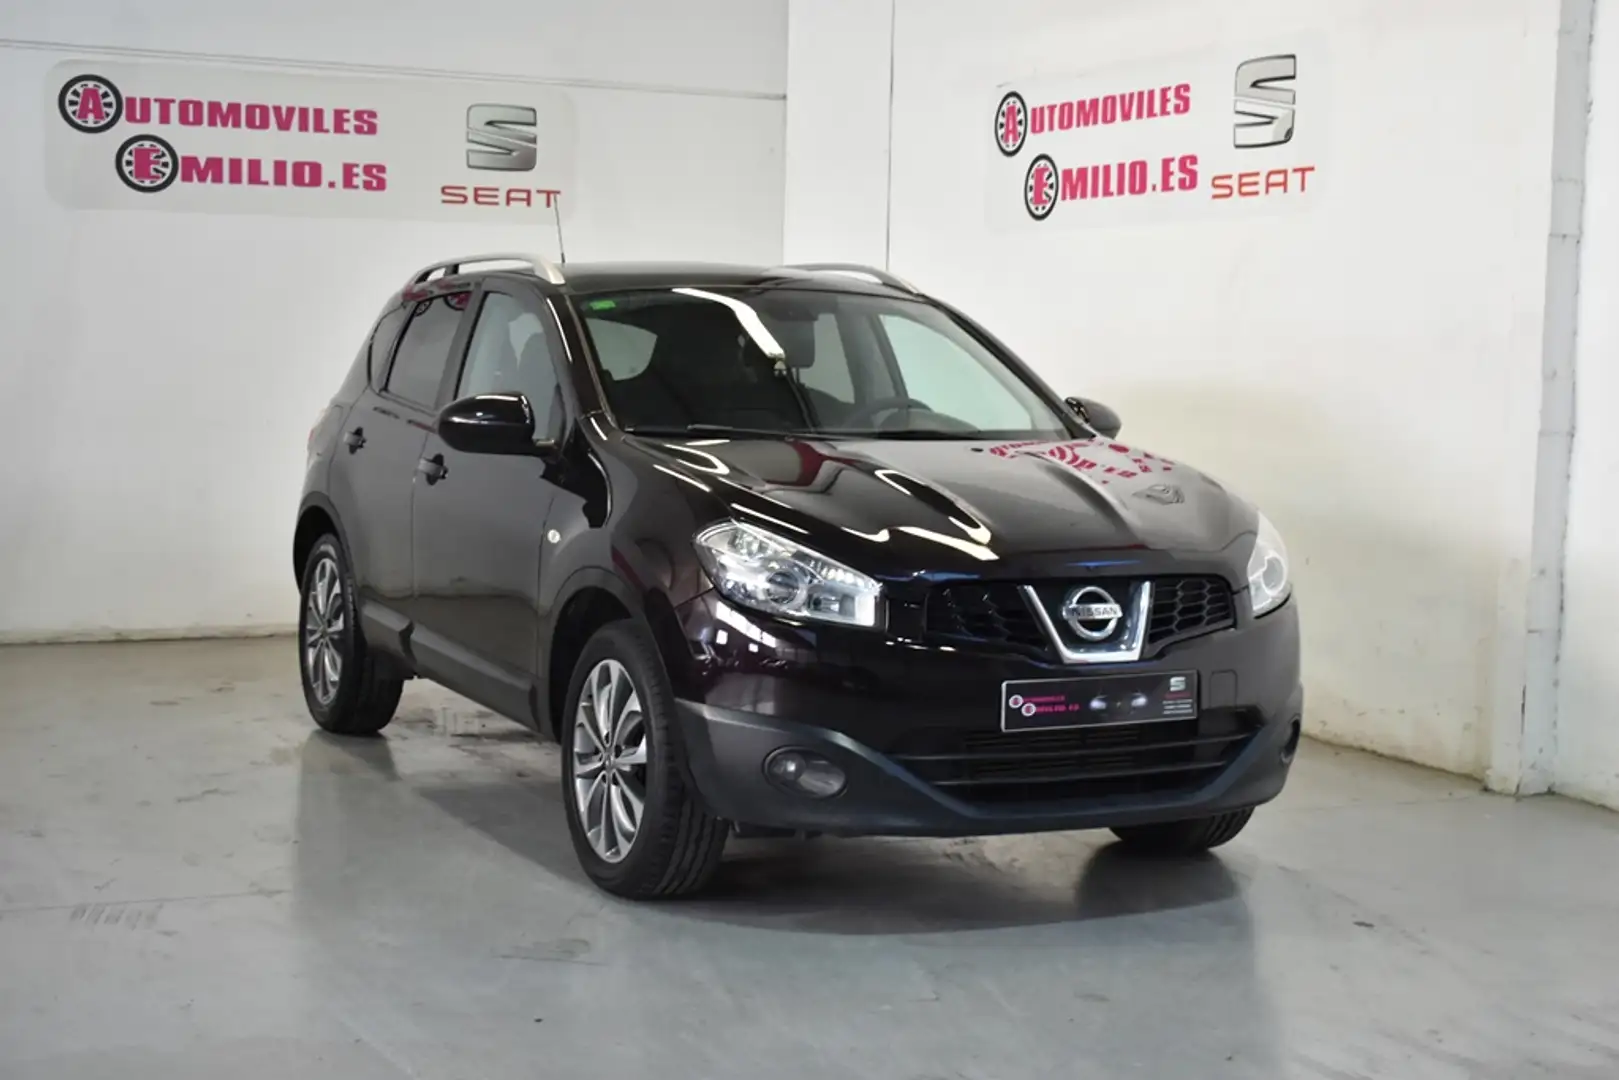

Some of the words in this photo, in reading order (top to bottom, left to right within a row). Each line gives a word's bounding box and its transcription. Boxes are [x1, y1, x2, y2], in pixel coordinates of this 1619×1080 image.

[76, 87, 378, 135] AUTOMOVILES
[1002, 83, 1192, 144] AUTOMOVILES
[131, 147, 387, 192] EMILIO.ES
[1032, 154, 1199, 206] EMILIO.ES
[1211, 166, 1315, 199] SEAT
[440, 185, 561, 209] SEAT
[1071, 606, 1118, 617] NISSAN
